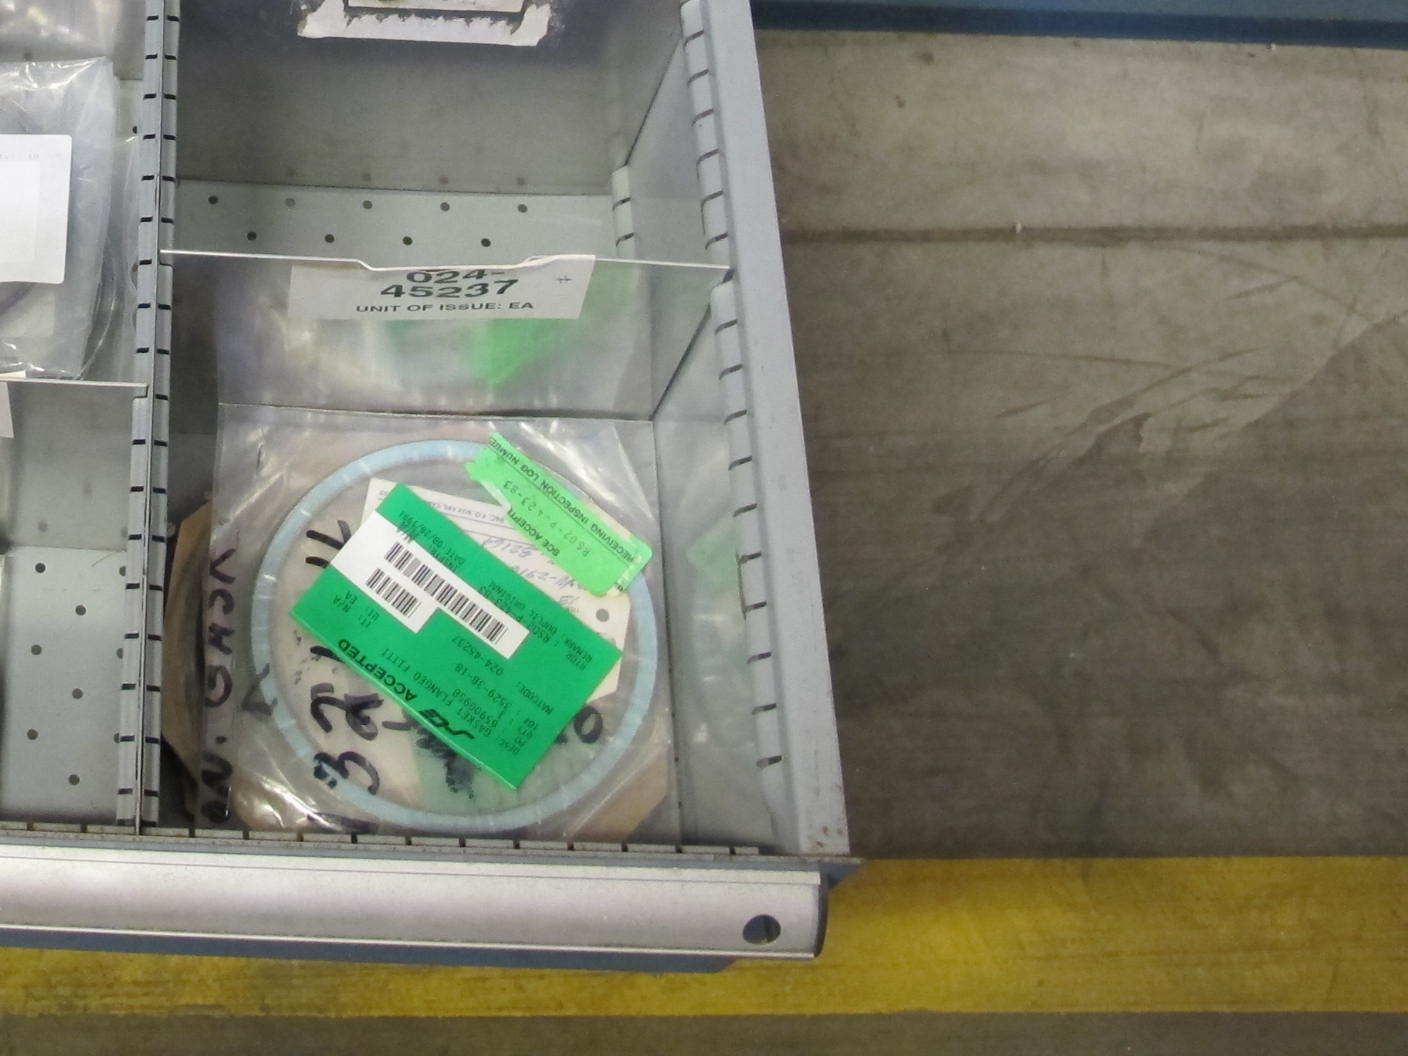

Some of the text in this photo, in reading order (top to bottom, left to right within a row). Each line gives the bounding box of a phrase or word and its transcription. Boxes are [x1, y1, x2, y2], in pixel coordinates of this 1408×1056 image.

[406, 269, 505, 284] 024-
[379, 279, 519, 298] 45237
[356, 305, 400, 313] UNIT
[407, 304, 434, 312] OF
[509, 302, 535, 310] EA
[520, 463, 540, 482] LOG
[540, 479, 590, 525] INSPECTION
[335, 637, 417, 704] ACCEPTED
